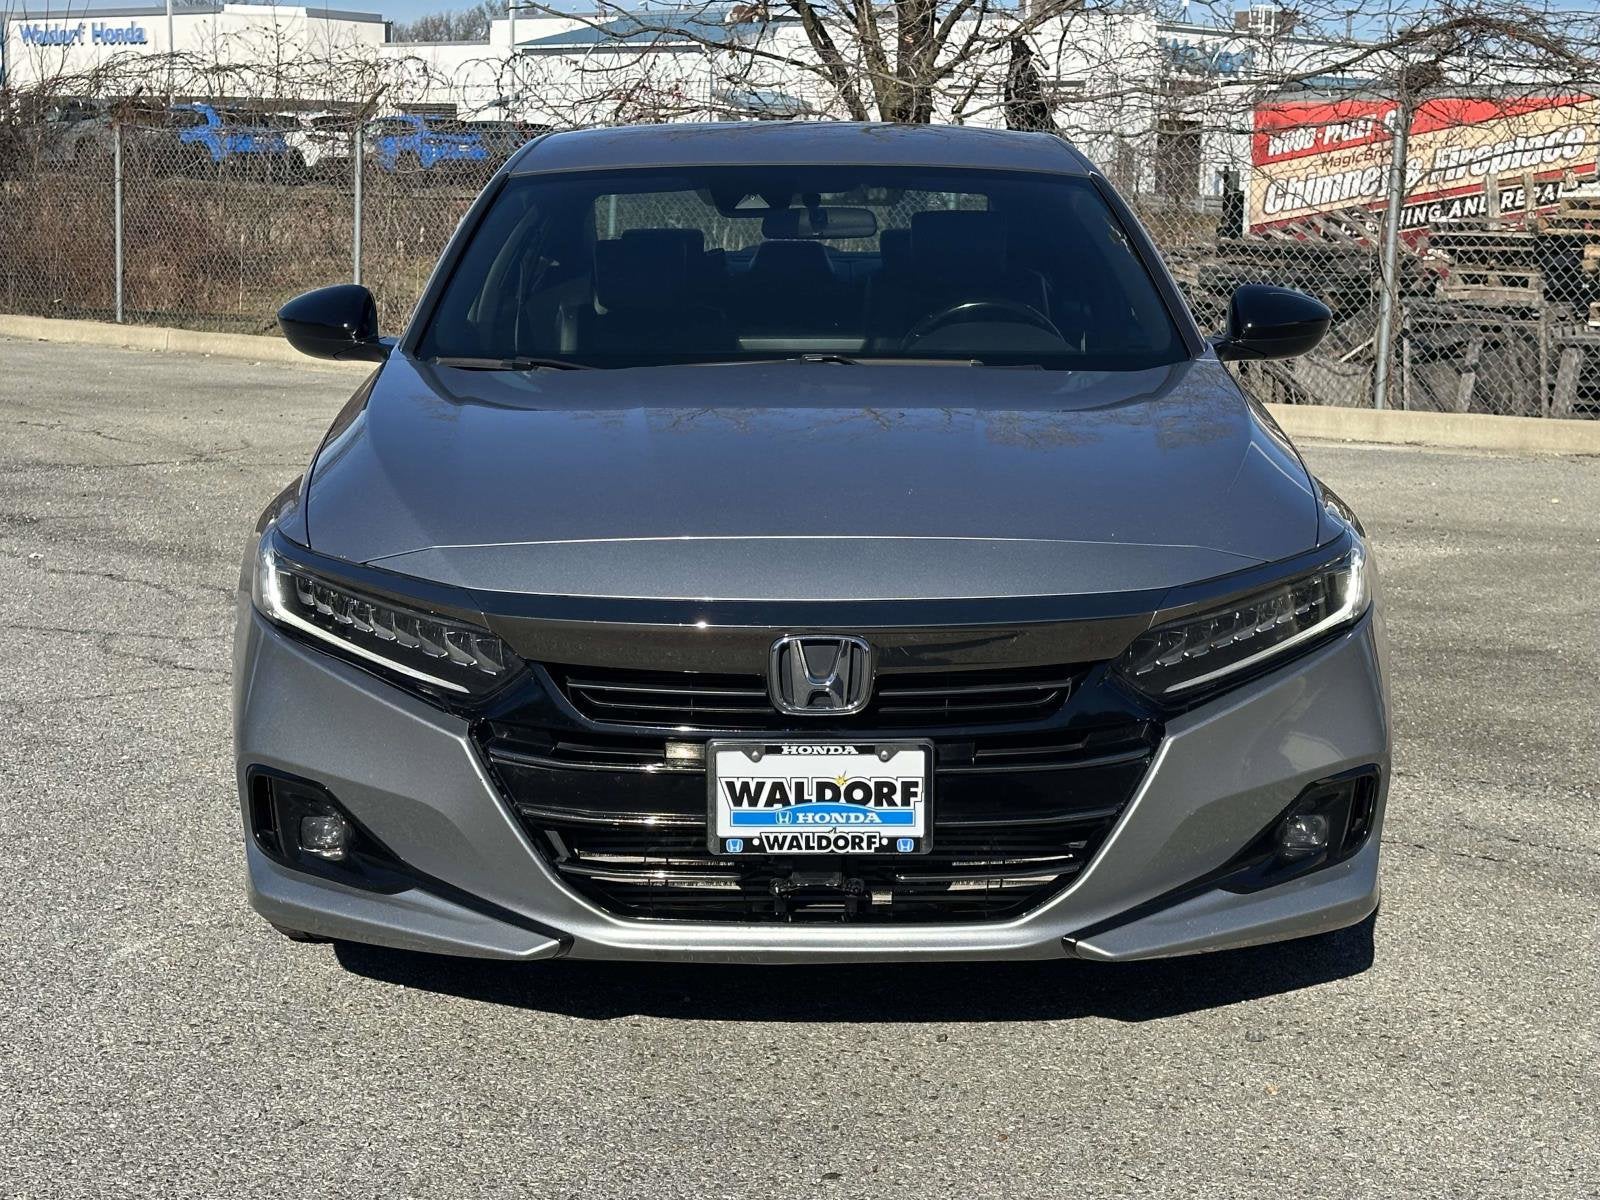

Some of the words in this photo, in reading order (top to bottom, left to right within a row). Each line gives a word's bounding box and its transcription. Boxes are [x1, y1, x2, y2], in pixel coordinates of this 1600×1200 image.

[19, 22, 86, 45] Waldorf
[91, 21, 147, 45] Honda
[1428, 126, 1587, 185] Fireplace
[780, 744, 859, 755] HONDA
[724, 780, 920, 808] WALDORF
[796, 812, 883, 824] HONDA
[763, 834, 879, 851] WALDORF
